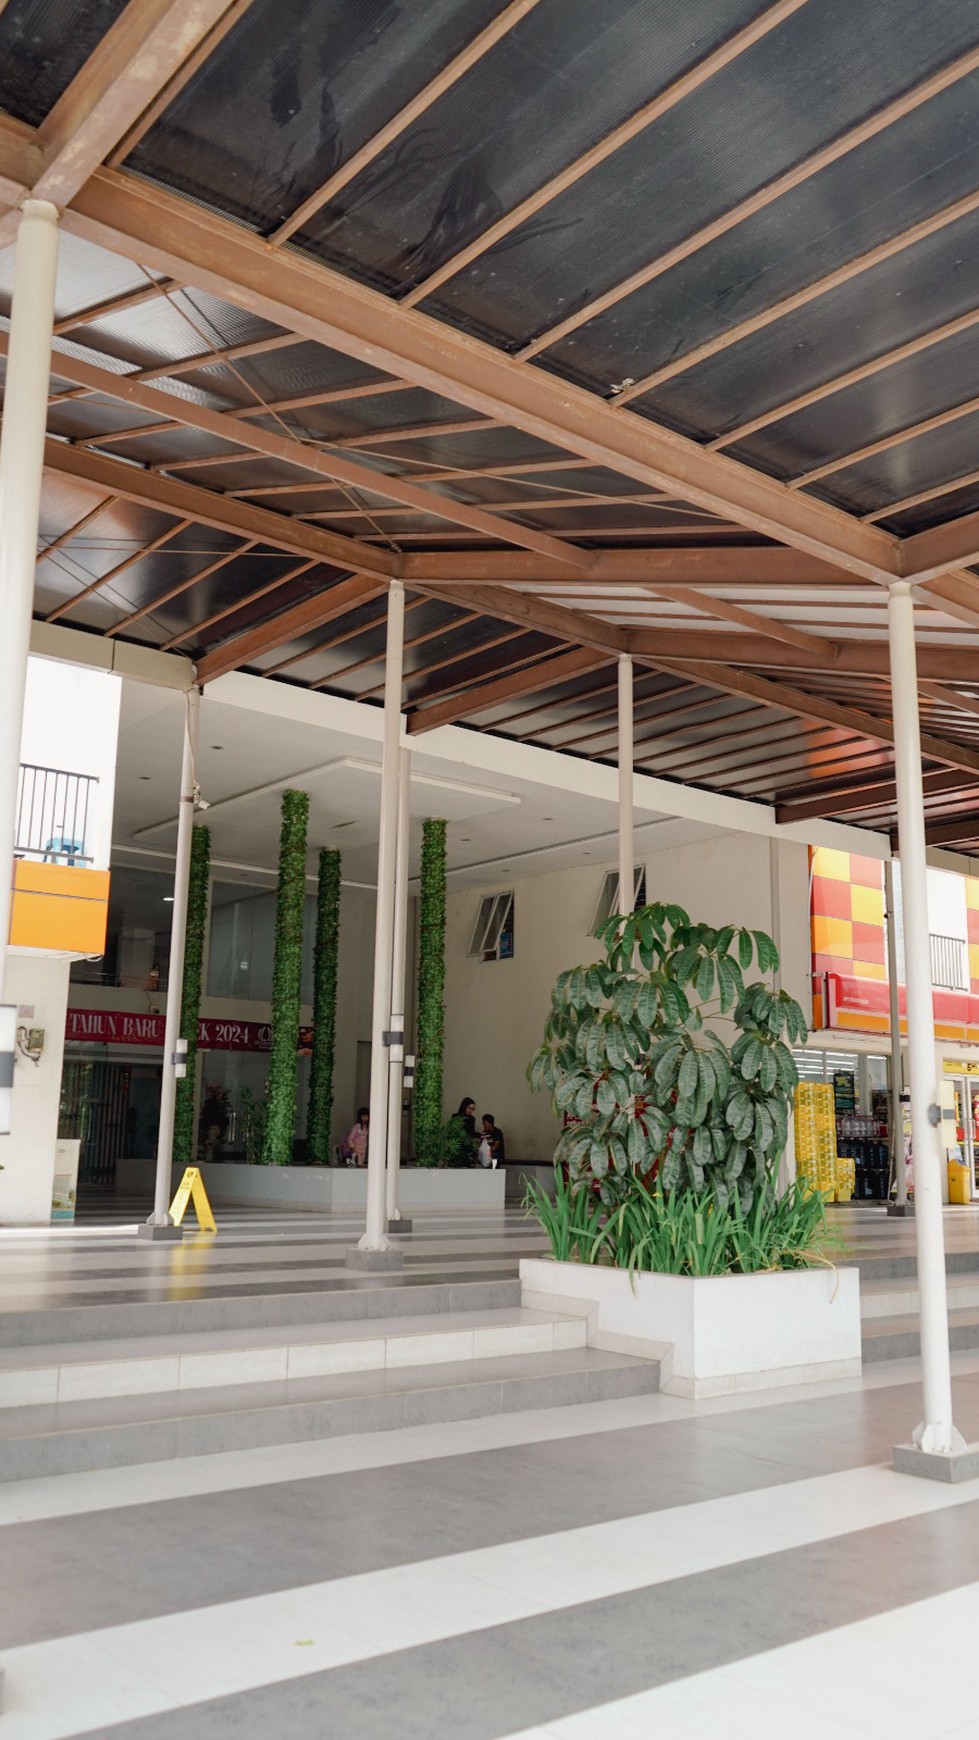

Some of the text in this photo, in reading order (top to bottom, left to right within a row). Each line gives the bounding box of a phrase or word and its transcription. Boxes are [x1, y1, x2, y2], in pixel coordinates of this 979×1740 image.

[69, 1013, 117, 1034] TAHUN
[123, 1017, 161, 1038] BARU
[215, 1023, 249, 1043] 2024
